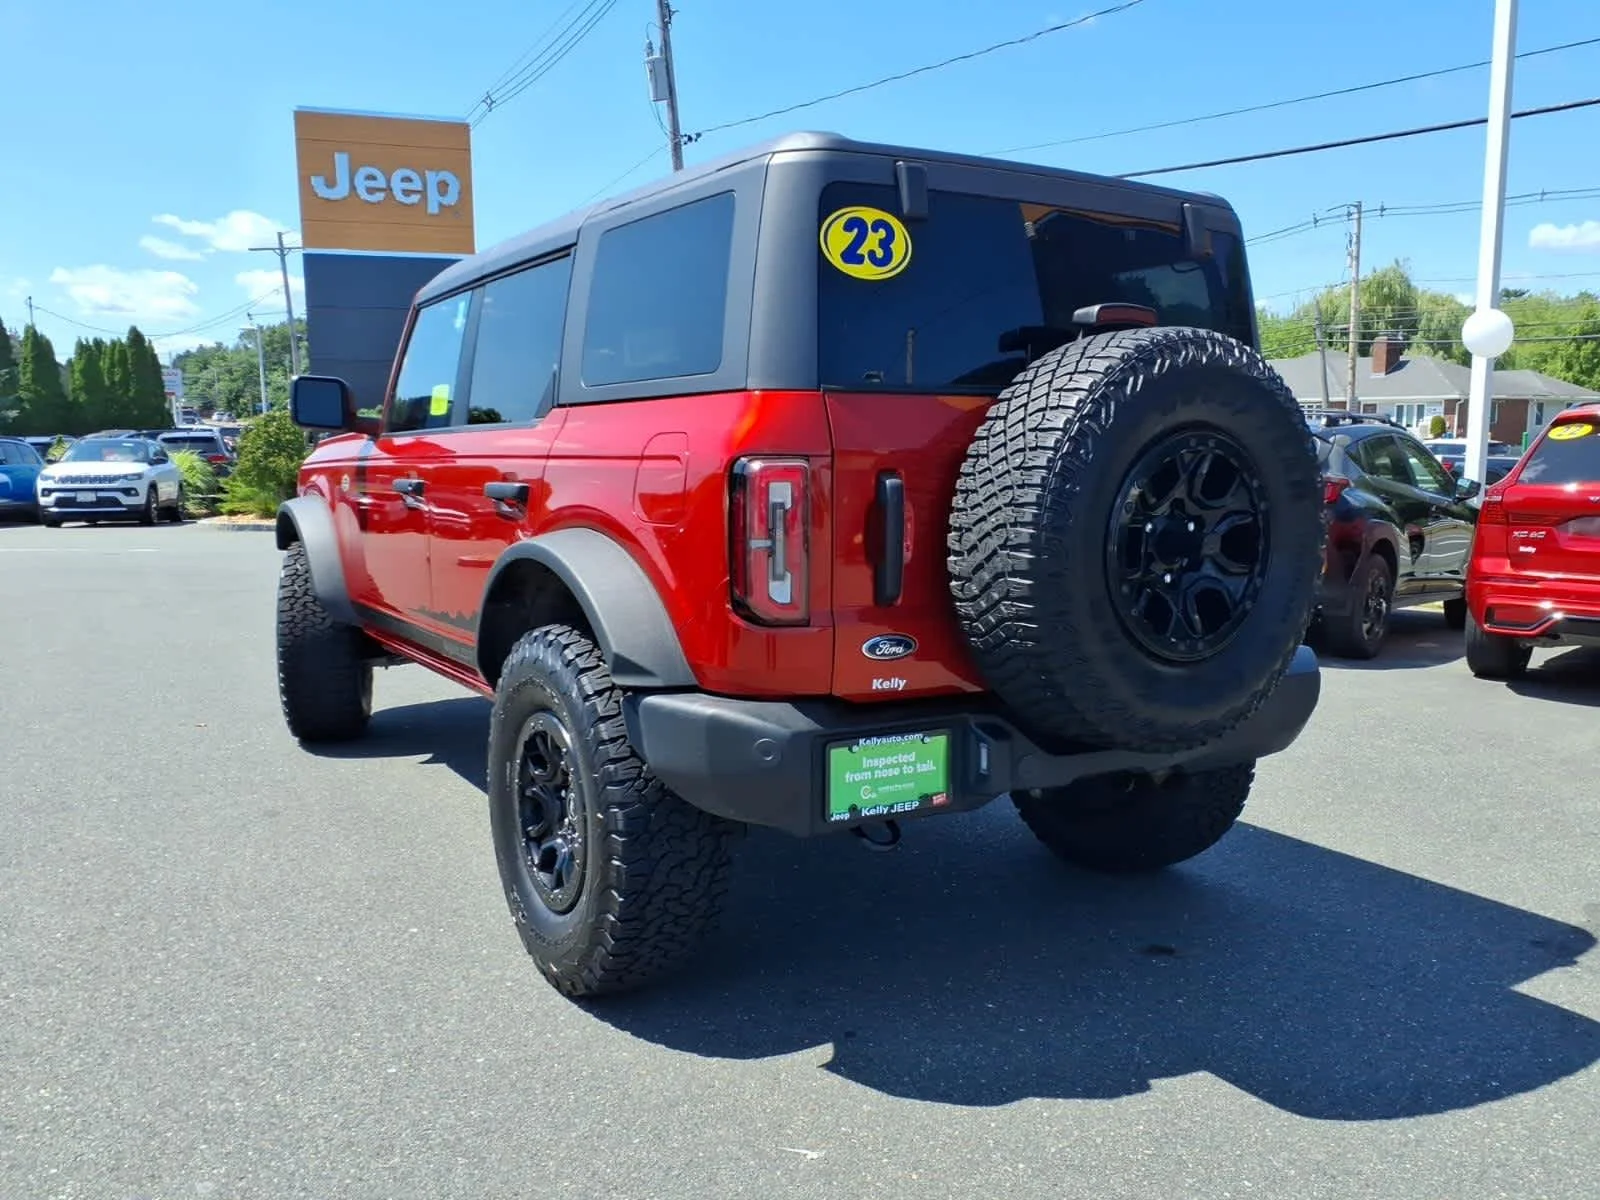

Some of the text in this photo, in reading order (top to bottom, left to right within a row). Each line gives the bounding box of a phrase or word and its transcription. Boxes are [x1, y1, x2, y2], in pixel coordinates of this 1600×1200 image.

[310, 151, 460, 215] Jeep
[840, 216, 895, 268] 23
[876, 640, 905, 655] Ford
[872, 677, 906, 691] Kelly
[859, 733, 923, 746] Kellyauto.com
[863, 752, 916, 768] Inspected
[845, 771, 871, 783] from
[874, 767, 901, 779] nose
[902, 764, 914, 774] to
[861, 800, 920, 816] Kelly JEEP
[831, 812, 850, 821] Jeep
